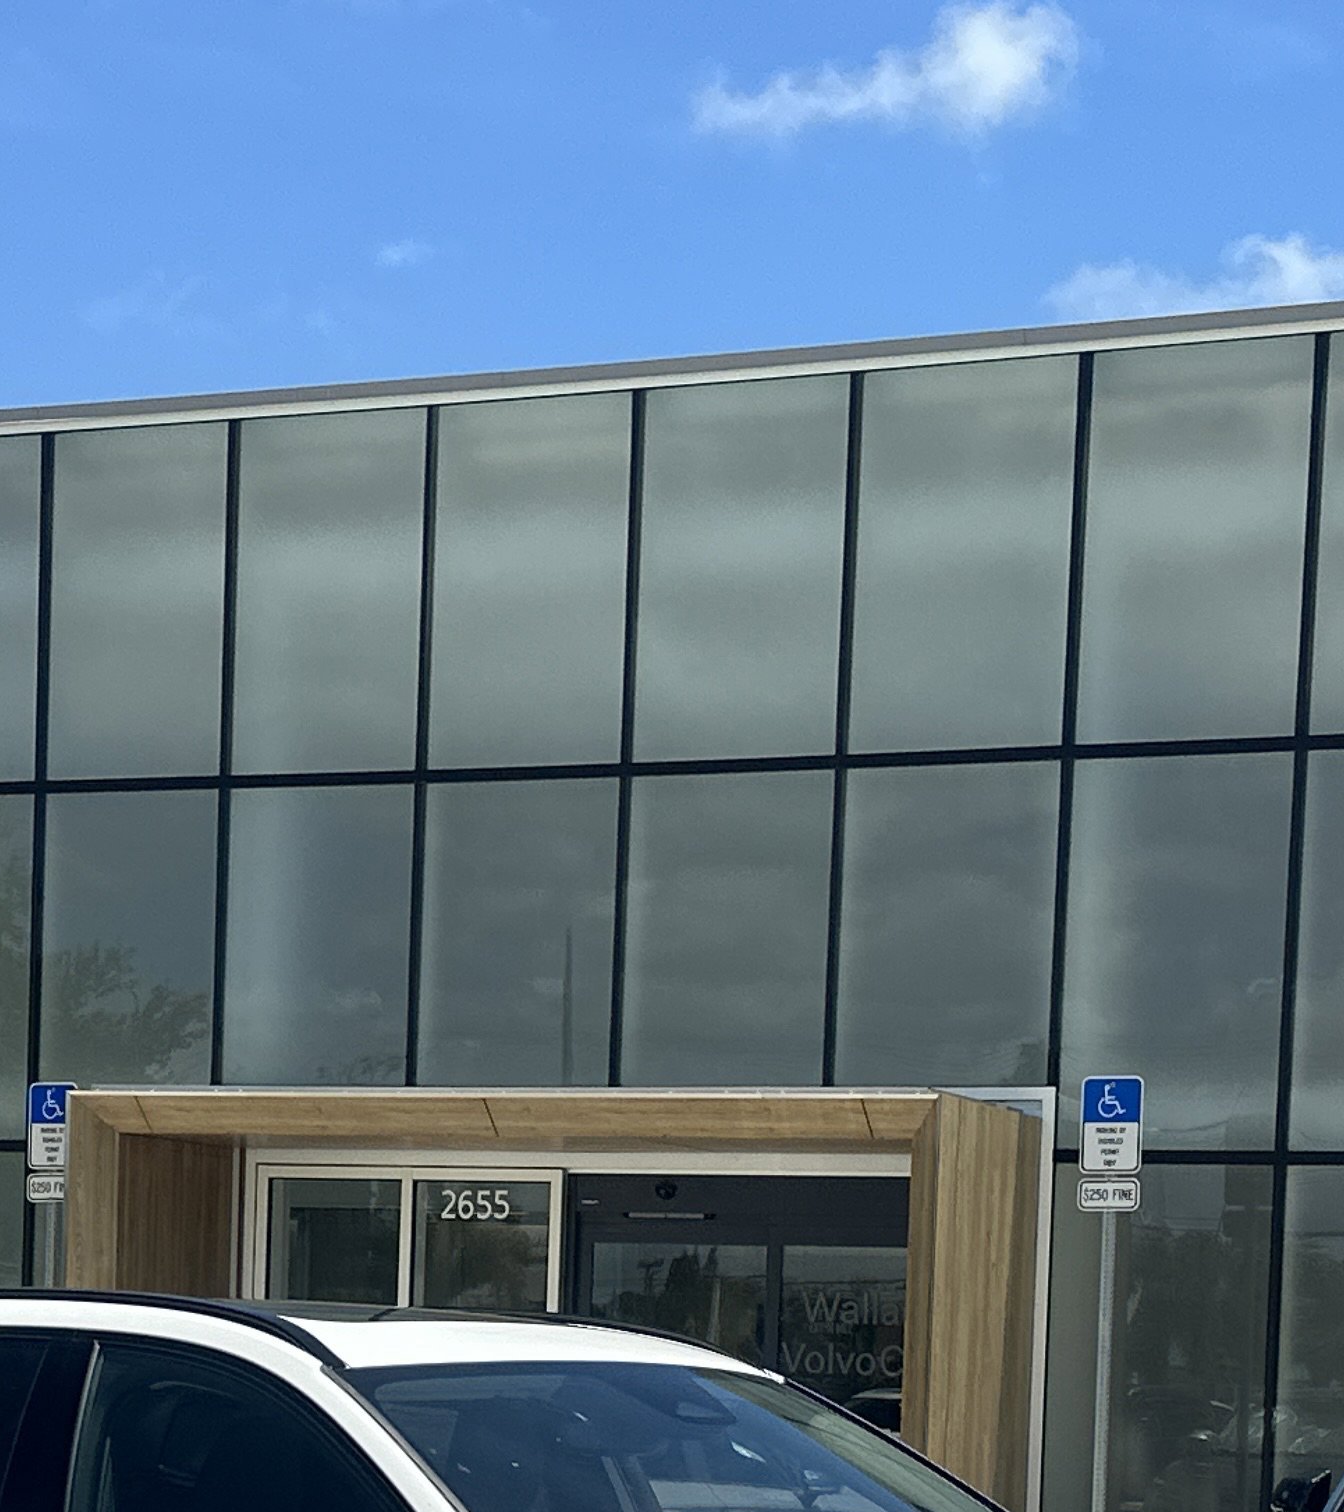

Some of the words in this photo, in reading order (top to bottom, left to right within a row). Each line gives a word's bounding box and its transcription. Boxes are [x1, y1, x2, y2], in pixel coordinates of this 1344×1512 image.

[441, 1189, 510, 1220] 2655
[1083, 1186, 1109, 1203] $250
[1112, 1188, 1134, 1201] FINE
